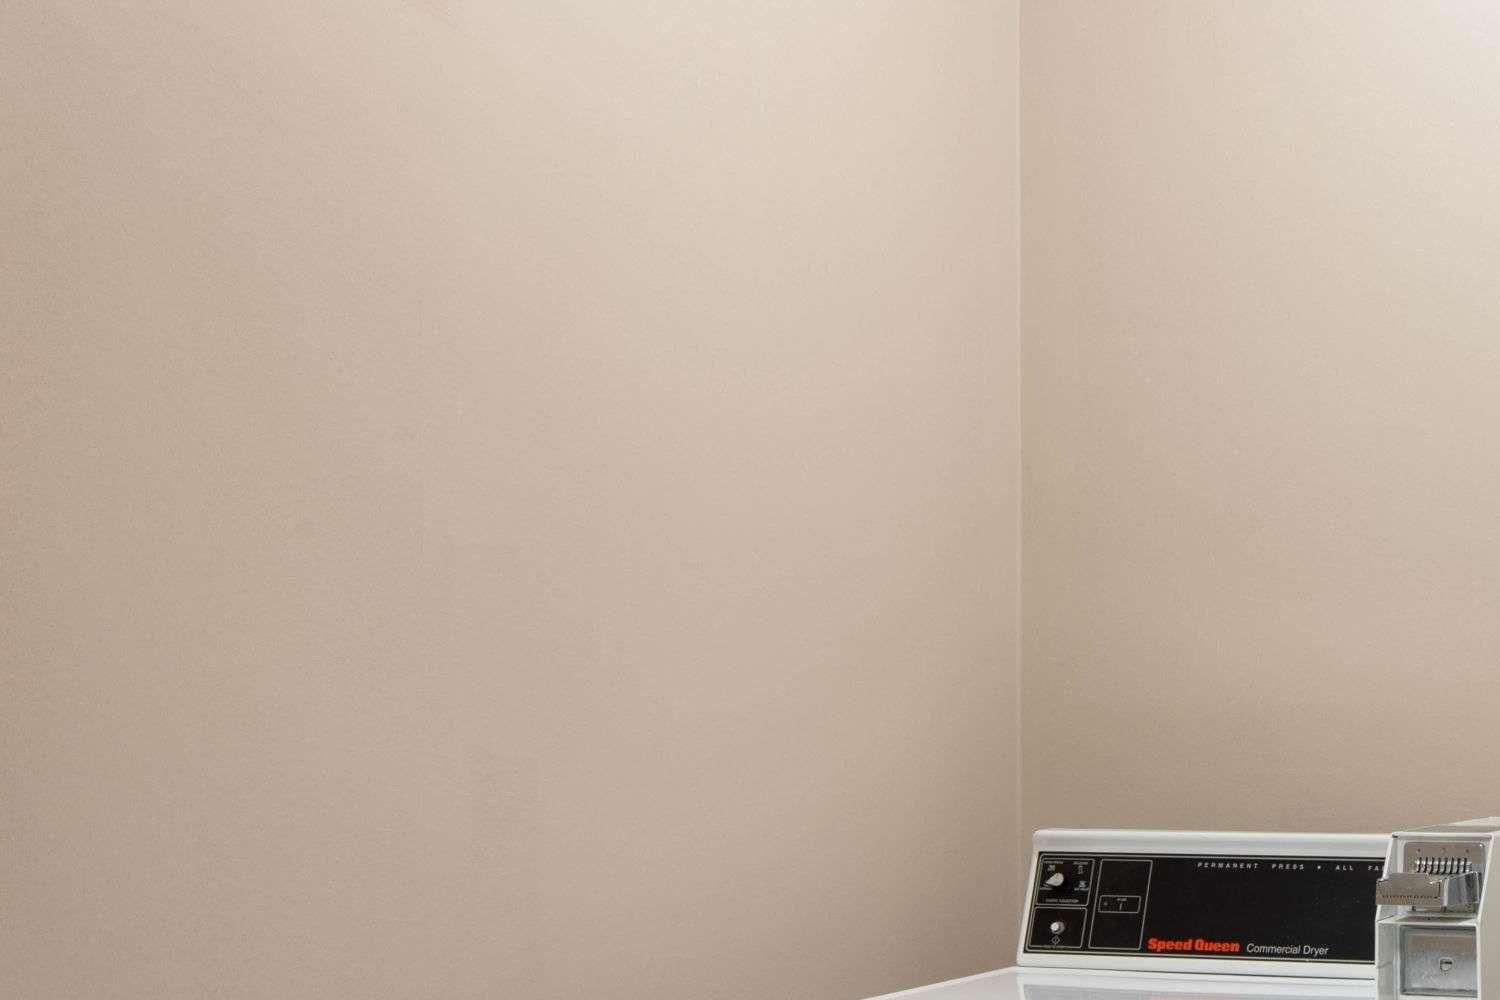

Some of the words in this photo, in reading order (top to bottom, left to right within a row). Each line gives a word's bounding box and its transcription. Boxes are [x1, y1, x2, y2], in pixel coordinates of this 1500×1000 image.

[1147, 938, 1193, 953] Speed
[1194, 939, 1241, 953] Queen
[1246, 943, 1301, 954] Commercial
[1303, 945, 1329, 956] Dryer
